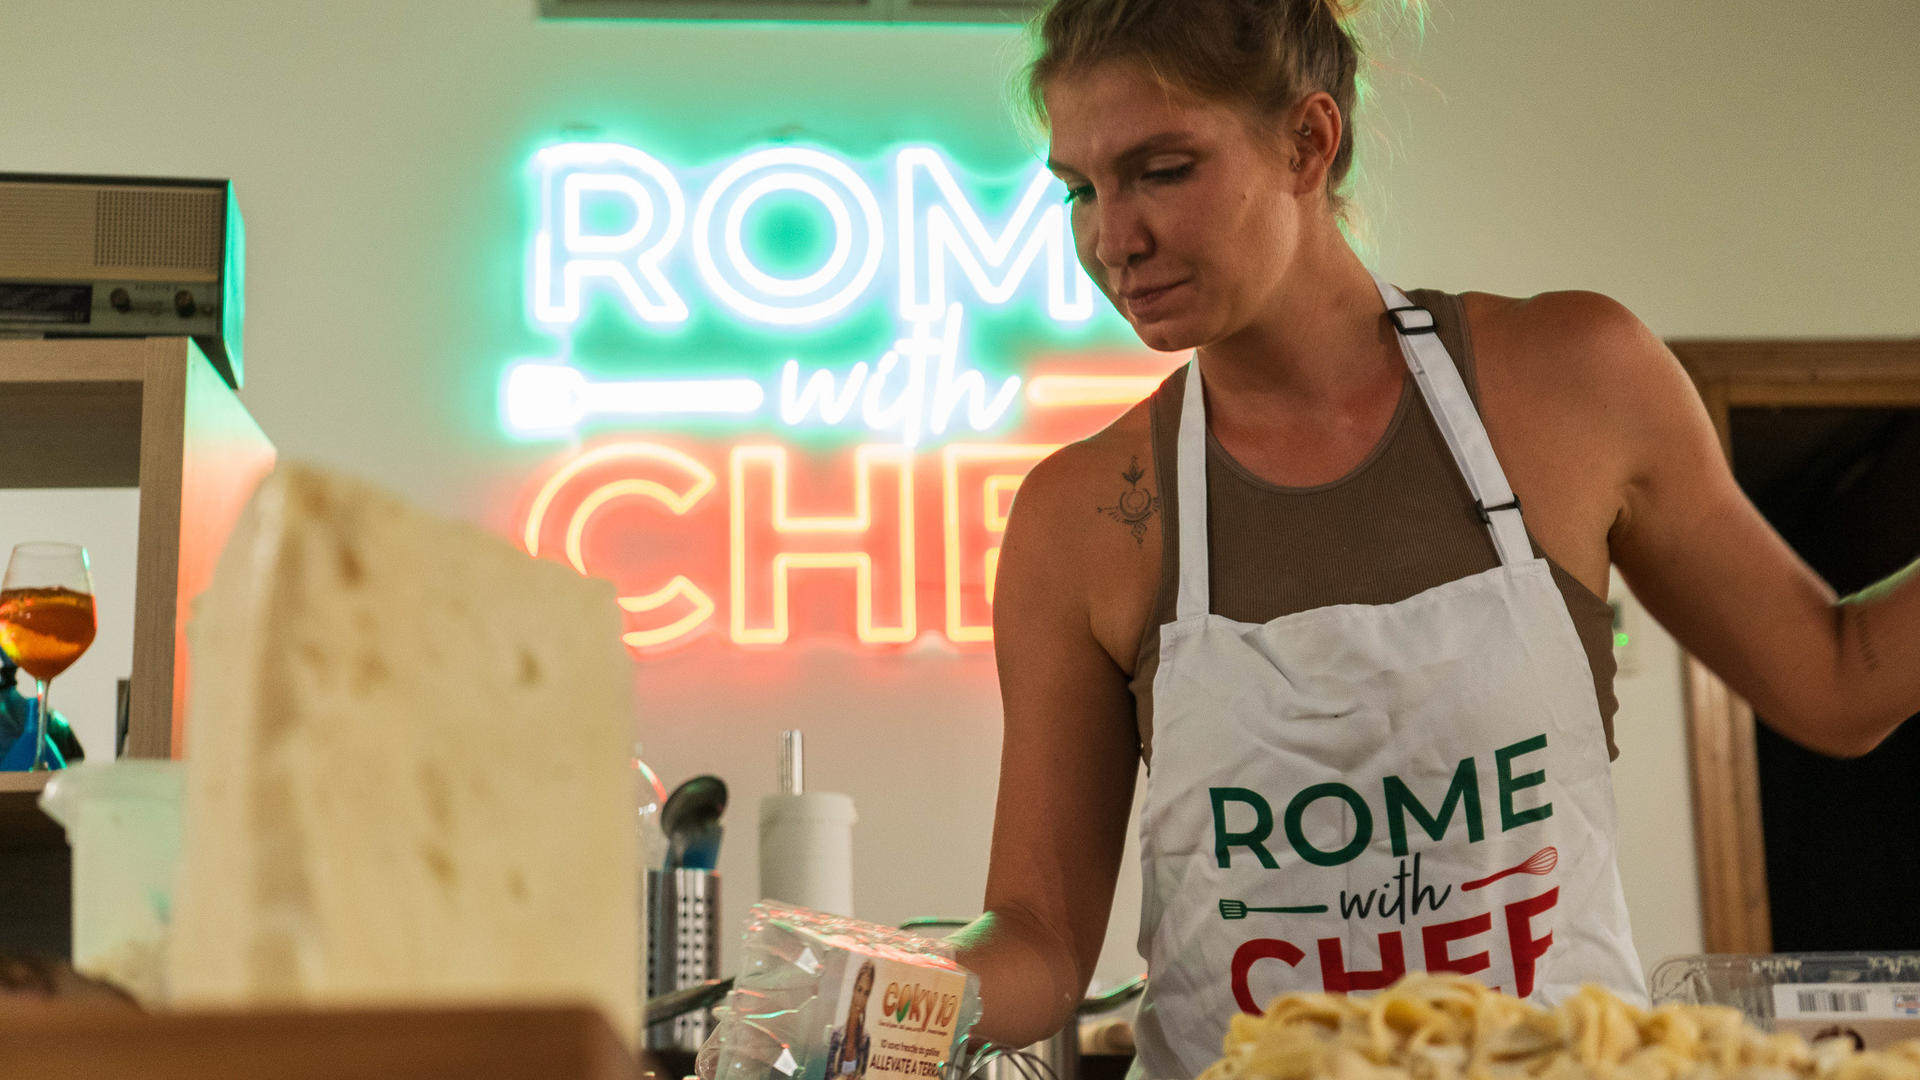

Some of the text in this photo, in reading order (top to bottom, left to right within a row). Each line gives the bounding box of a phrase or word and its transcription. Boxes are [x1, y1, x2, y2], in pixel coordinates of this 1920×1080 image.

[532, 142, 1093, 324] ROM
[780, 301, 1022, 449] with
[525, 442, 1066, 644] CHE
[1208, 733, 1553, 869] ROME
[1230, 886, 1560, 1017] CHEF
[1339, 852, 1451, 925] with
[870, 1054, 912, 1074] ALLEVATE
